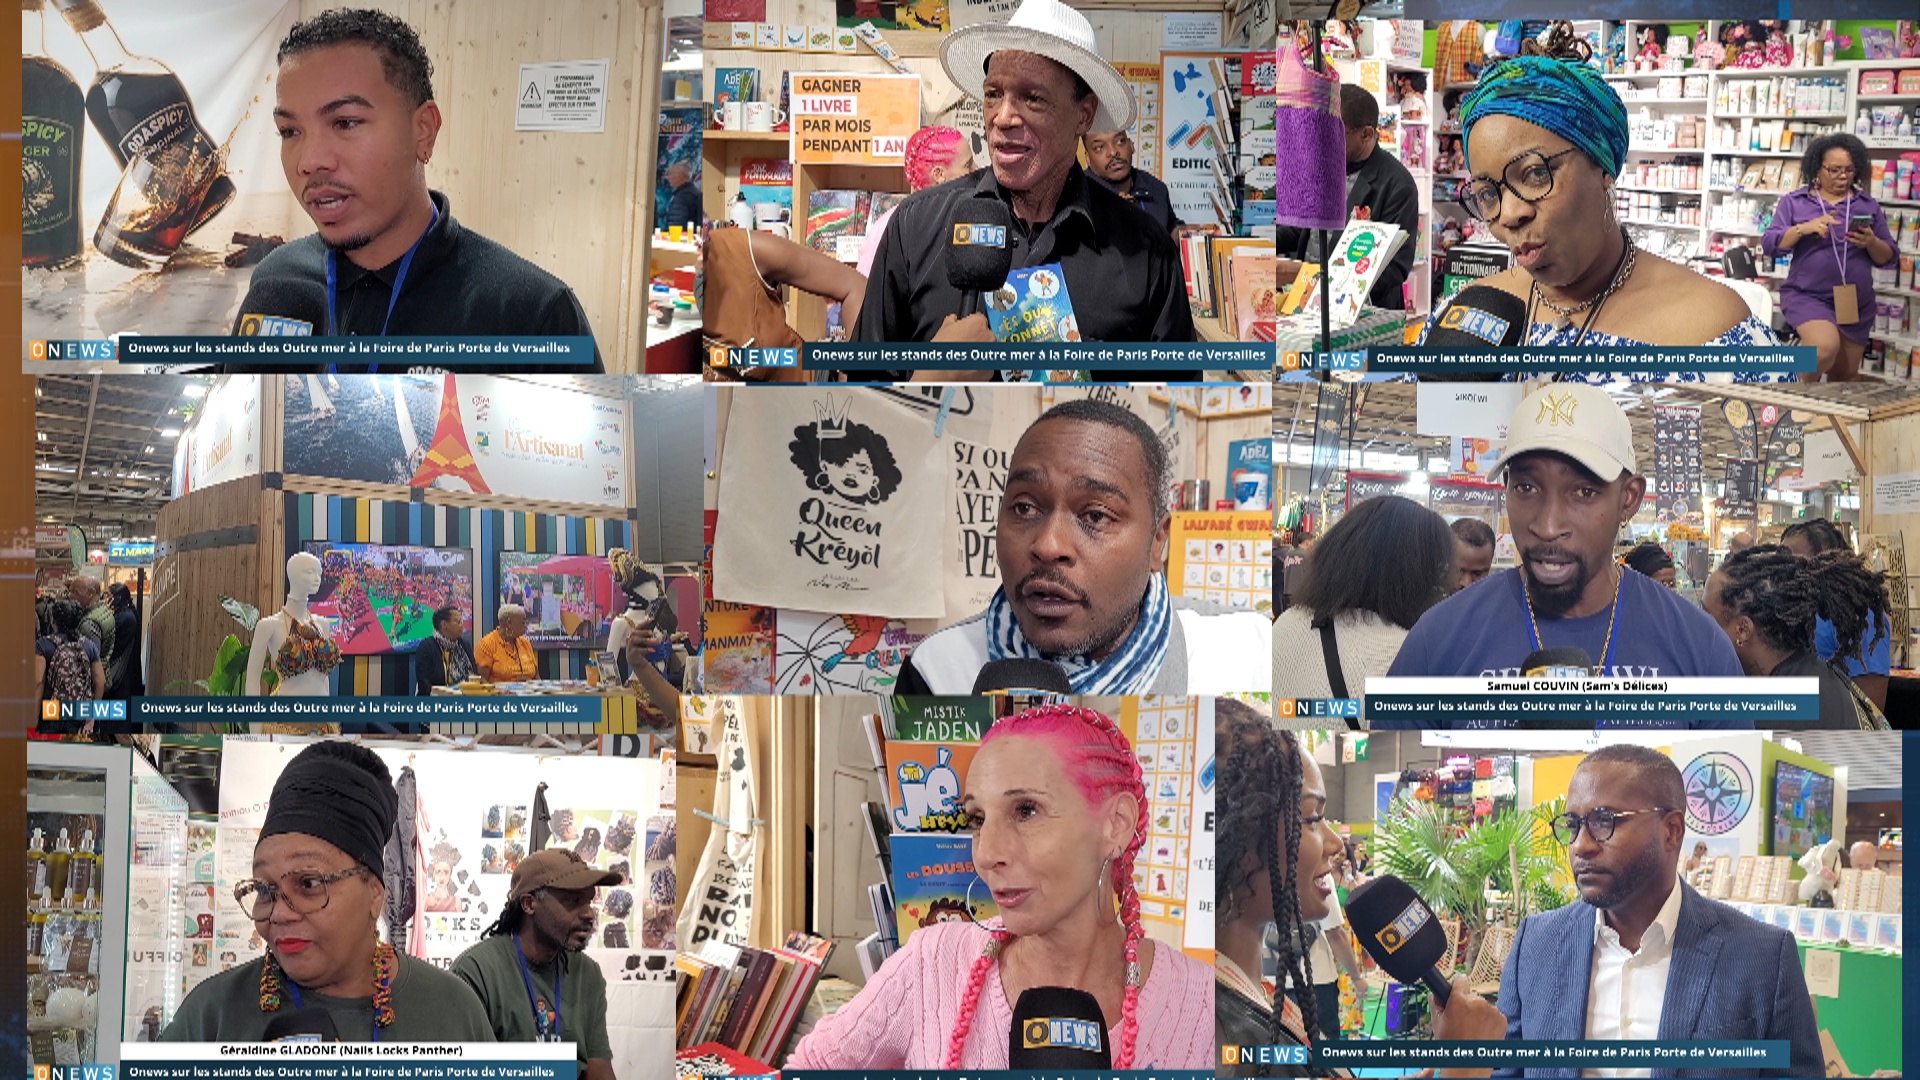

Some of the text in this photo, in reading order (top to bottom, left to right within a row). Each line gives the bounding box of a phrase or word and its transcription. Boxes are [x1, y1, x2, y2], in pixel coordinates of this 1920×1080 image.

[801, 79, 862, 94] GAGNER
[802, 99, 852, 113] 1 LIVRE
[802, 119, 871, 133] PAR MOIS
[802, 139, 905, 153] PENDANT 1 AN
[955, 225, 1003, 244] ONEWS
[1446, 306, 1504, 341] ONEWS
[504, 429, 585, 462] l'Artisanat
[954, 442, 976, 466] SI
[800, 498, 882, 542] Queen
[790, 530, 881, 570] Kréyòl
[924, 705, 966, 719] MISTIK
[911, 721, 981, 741] JADEN
[1026, 1019, 1098, 1046] ONEWS
